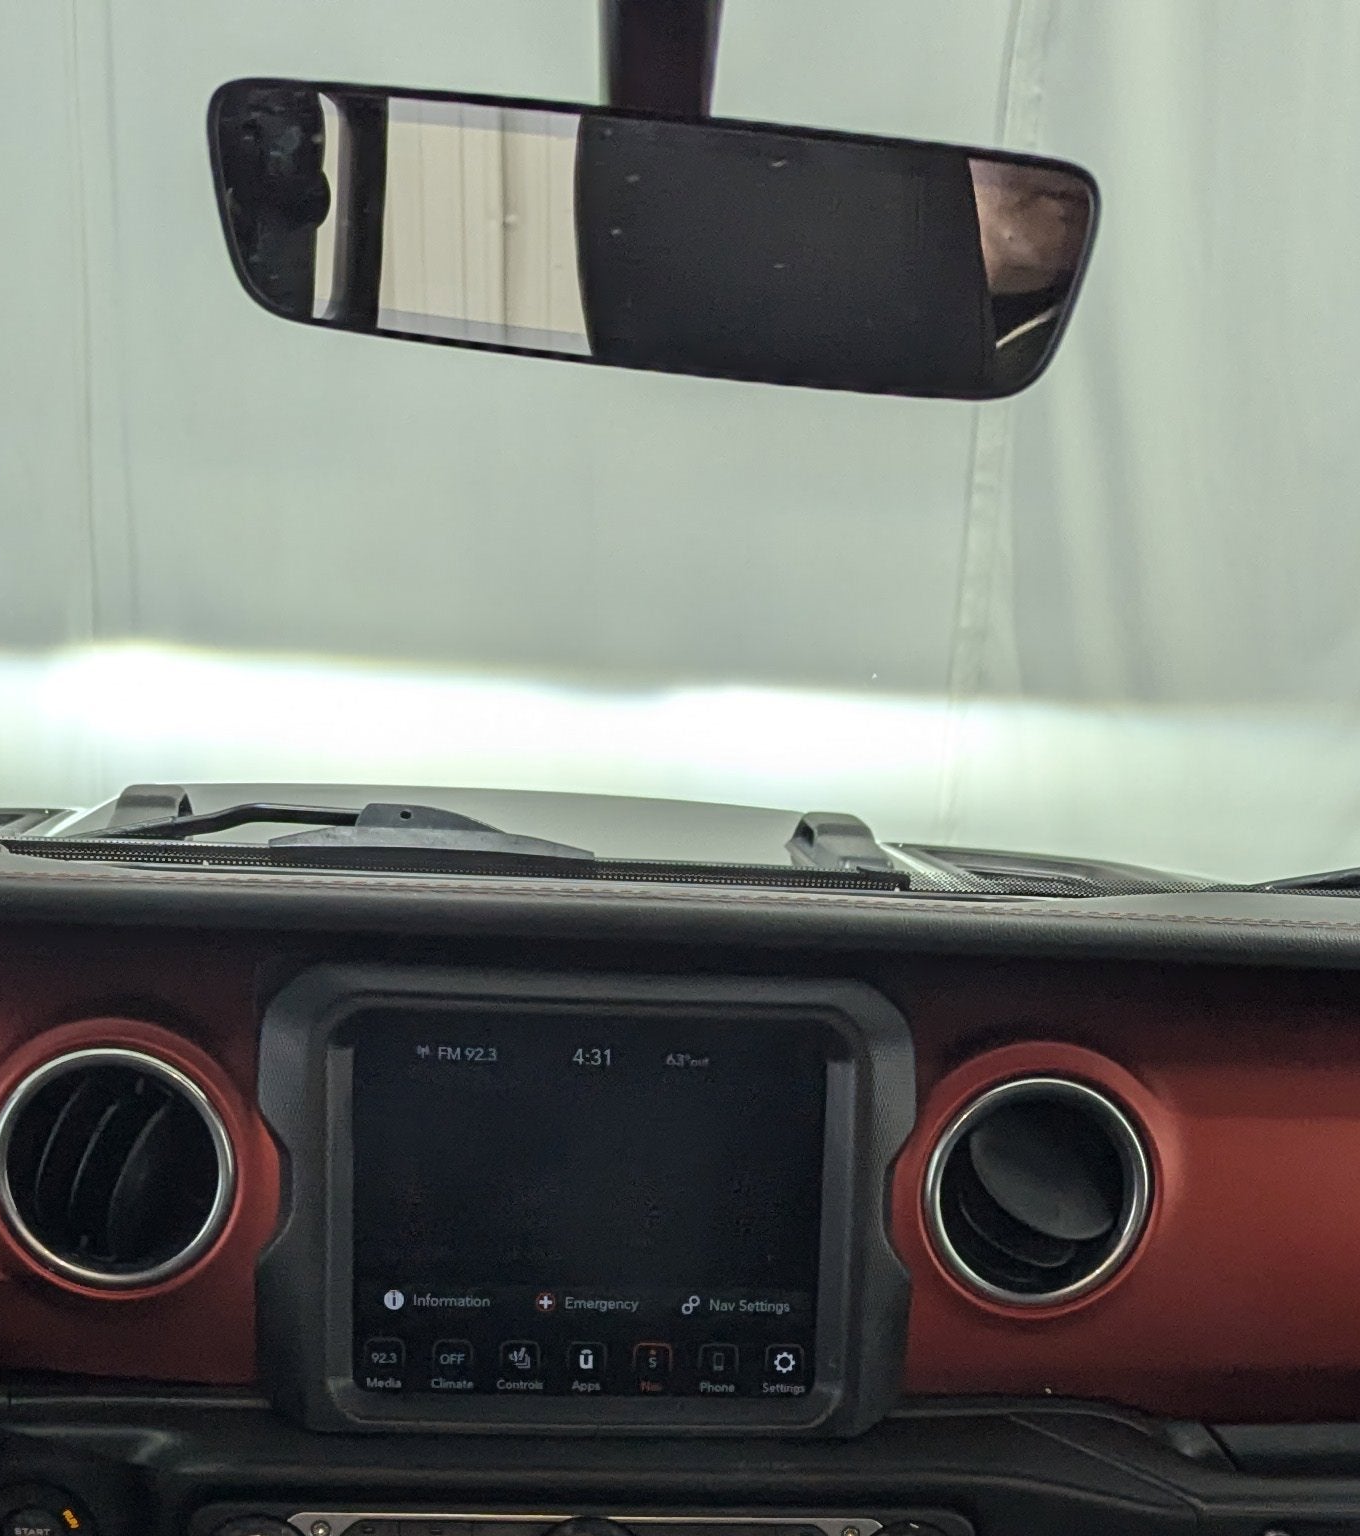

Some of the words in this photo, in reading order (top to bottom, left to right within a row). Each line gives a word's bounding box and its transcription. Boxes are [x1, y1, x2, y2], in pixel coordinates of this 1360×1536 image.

[438, 1046, 461, 1061] FM
[464, 1047, 497, 1061] 92.3
[572, 1048, 611, 1066] 4:31
[413, 1293, 491, 1308] Information
[565, 1296, 639, 1313] Emergency
[709, 1299, 735, 1312] Nav
[739, 1299, 790, 1315] Settings
[371, 1352, 397, 1364] 92.3
[440, 1353, 465, 1365] OFF
[366, 1377, 402, 1389] Media
[431, 1378, 474, 1390] Climate
[496, 1379, 544, 1391] Controls
[572, 1381, 601, 1393] Apps
[700, 1382, 735, 1393] Phone
[762, 1382, 805, 1395] Settings
[14, 1527, 50, 1536] START
